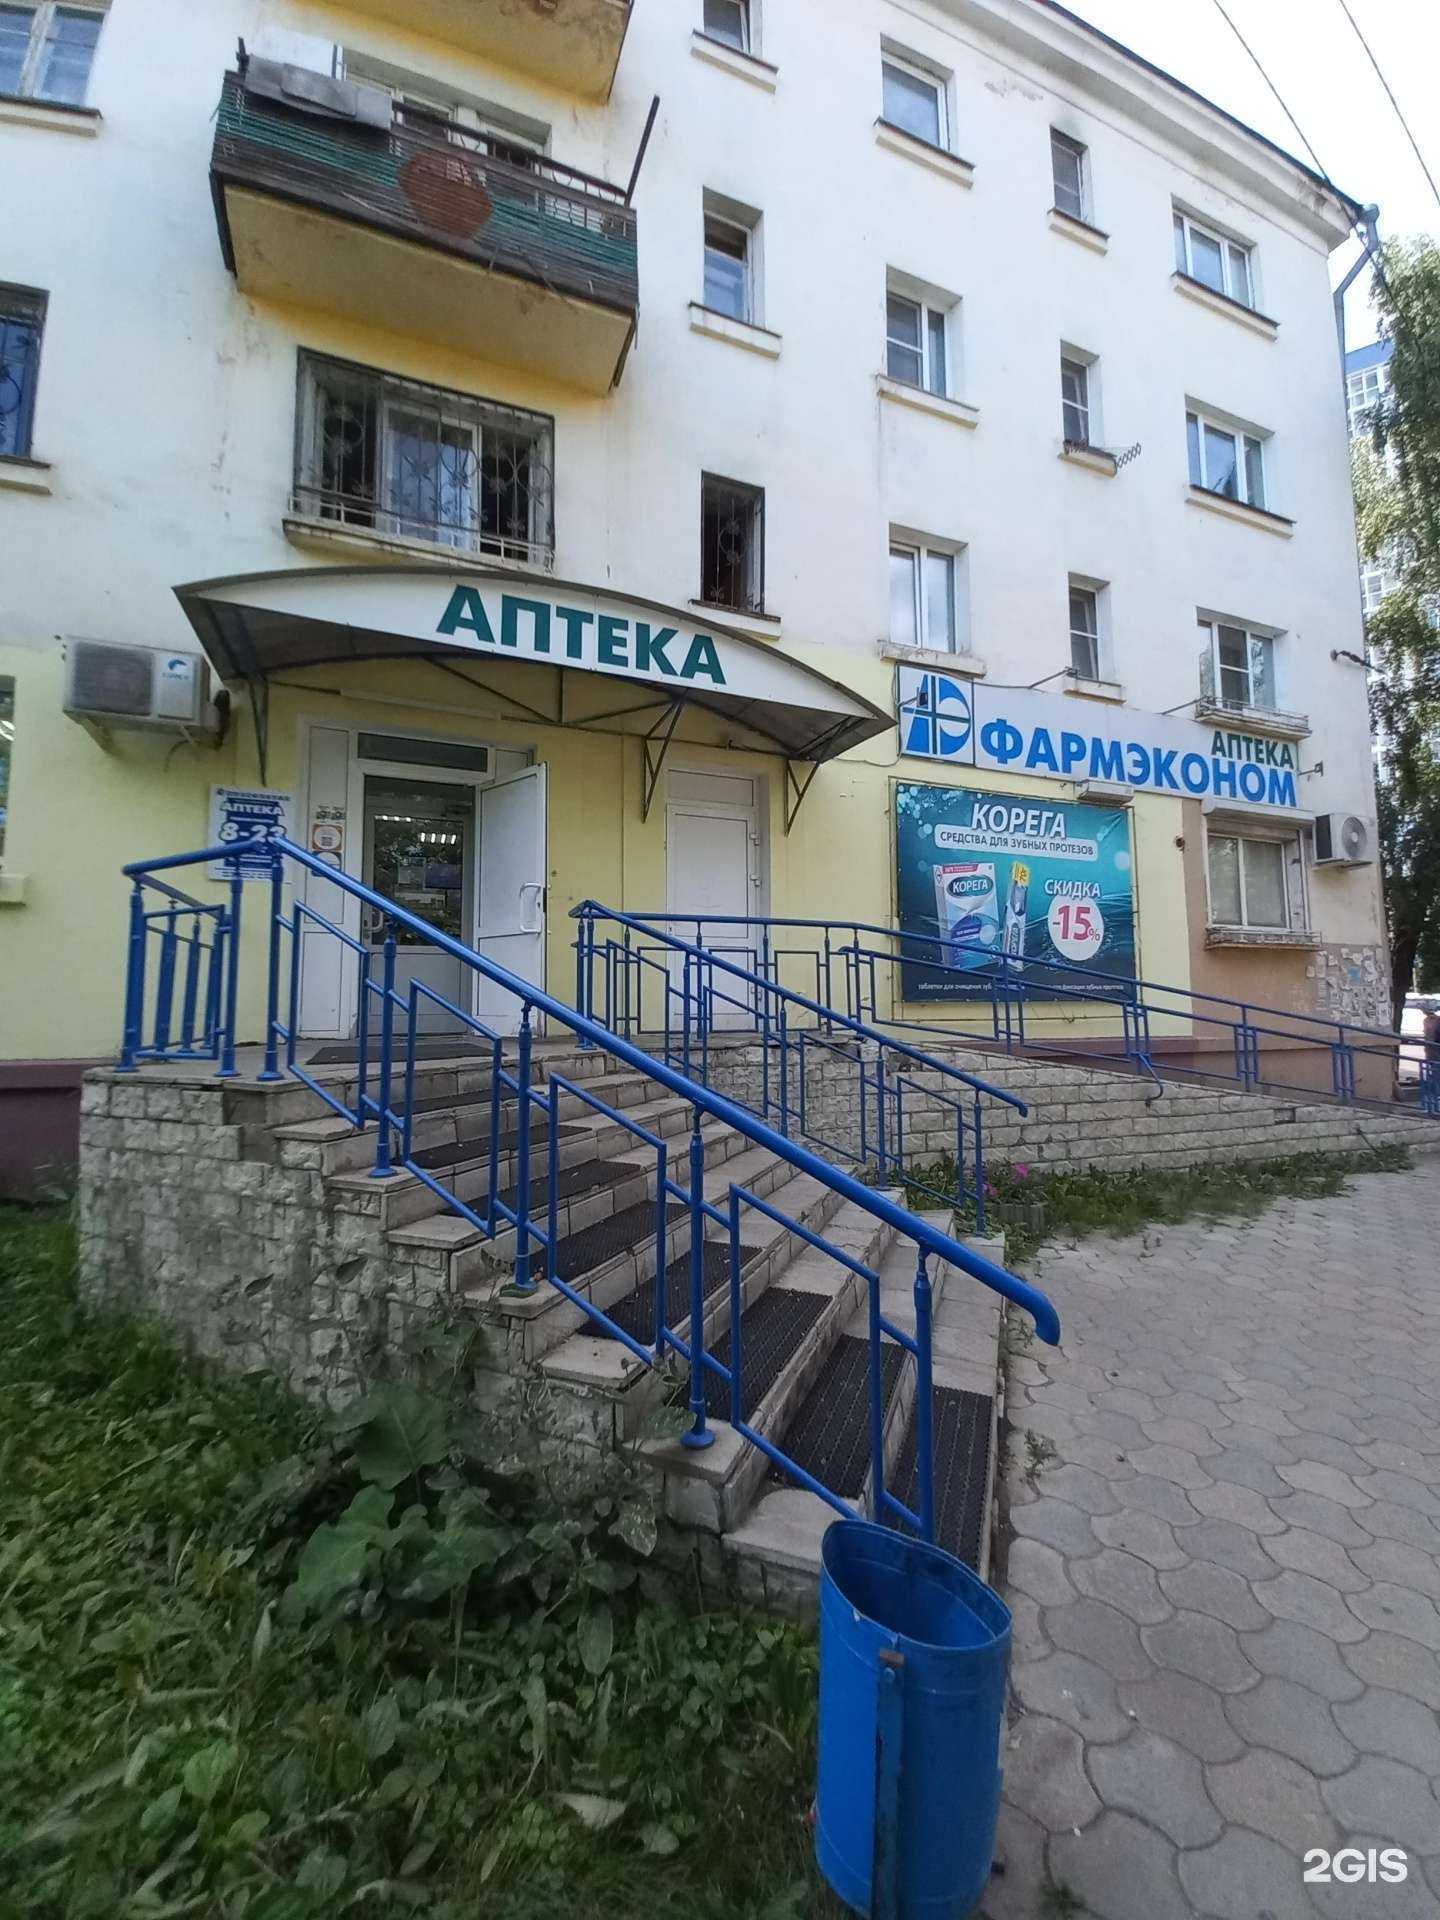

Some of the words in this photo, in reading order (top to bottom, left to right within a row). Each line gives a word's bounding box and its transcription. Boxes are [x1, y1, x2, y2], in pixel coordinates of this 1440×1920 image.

[436, 584, 726, 685] АПТЕКА
[1212, 731, 1293, 768] АПТЕКА
[981, 718, 1296, 807] ФАРМЭКОНОМ
[220, 801, 285, 816] АПТЕКА
[219, 821, 288, 842] 8-23
[972, 803, 1066, 838] КОРЕГА
[940, 832, 987, 845] СРЕДСТВА
[989, 837, 1009, 848] ДЛЯ
[1011, 839, 1047, 850] ЗУБНЫХ
[1050, 842, 1094, 855] ПРОТЕЗОВ
[953, 879, 988, 893] КОРЕГА
[1044, 879, 1100, 898] СКИДКА
